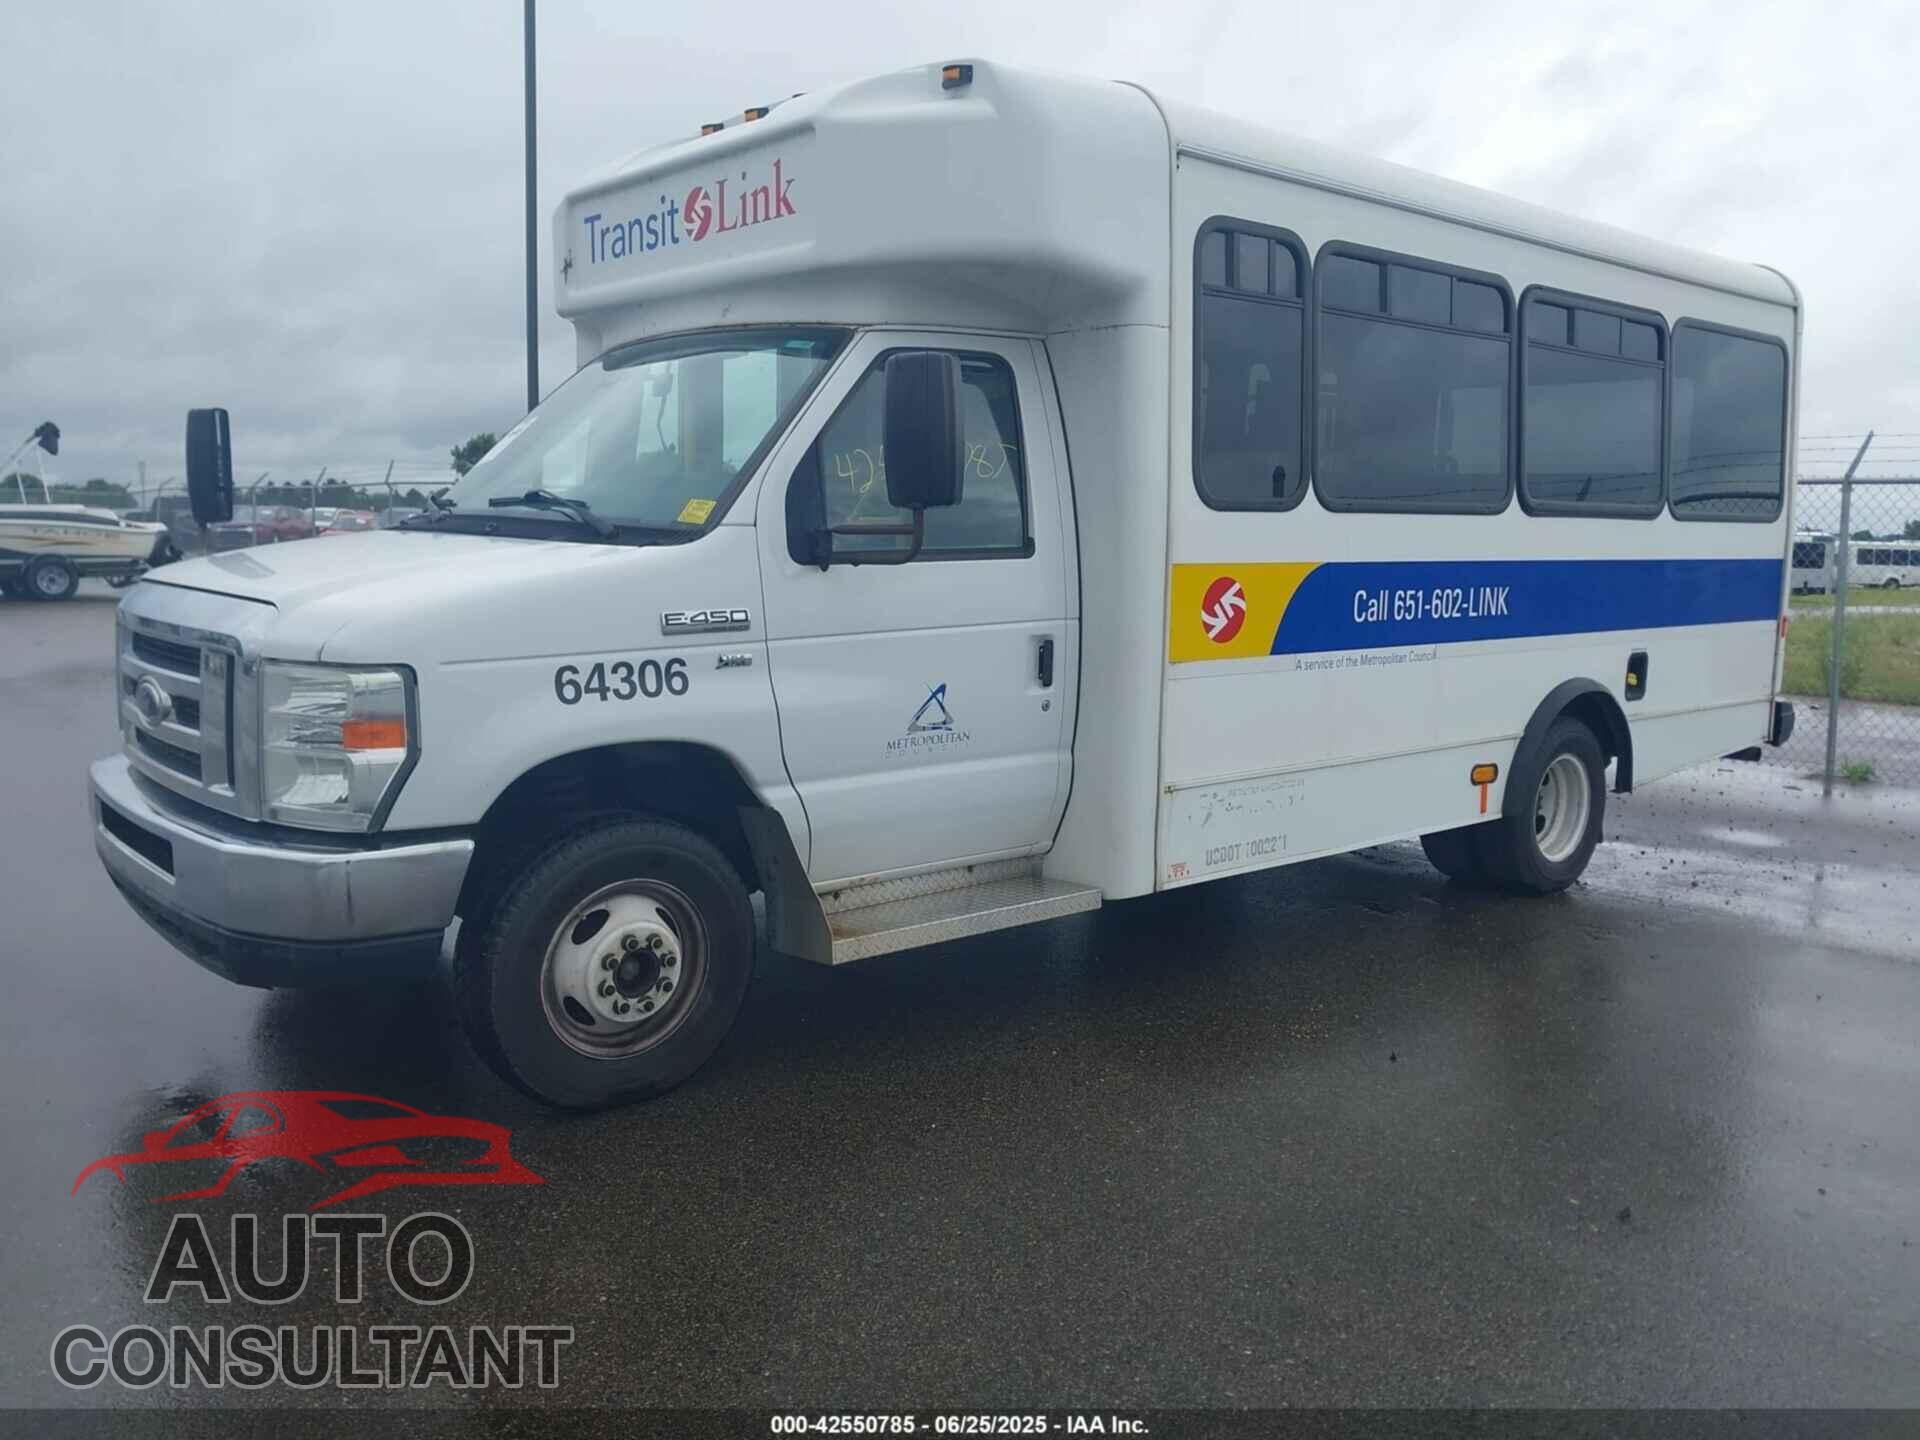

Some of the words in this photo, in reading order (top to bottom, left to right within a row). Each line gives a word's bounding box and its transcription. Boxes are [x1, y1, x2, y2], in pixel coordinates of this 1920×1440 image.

[584, 195, 680, 264] Transit
[716, 158, 796, 233] Link
[1353, 589, 1389, 623] Call
[1393, 586, 1510, 621] 651-602-LINK
[1304, 659, 1333, 671] service
[1335, 655, 1345, 668] of
[1345, 655, 1358, 667] the
[1360, 652, 1407, 668] Metropolitan
[1408, 644, 1438, 663] Council
[554, 657, 689, 705] 64306
[886, 731, 971, 751] METROPOLITAN
